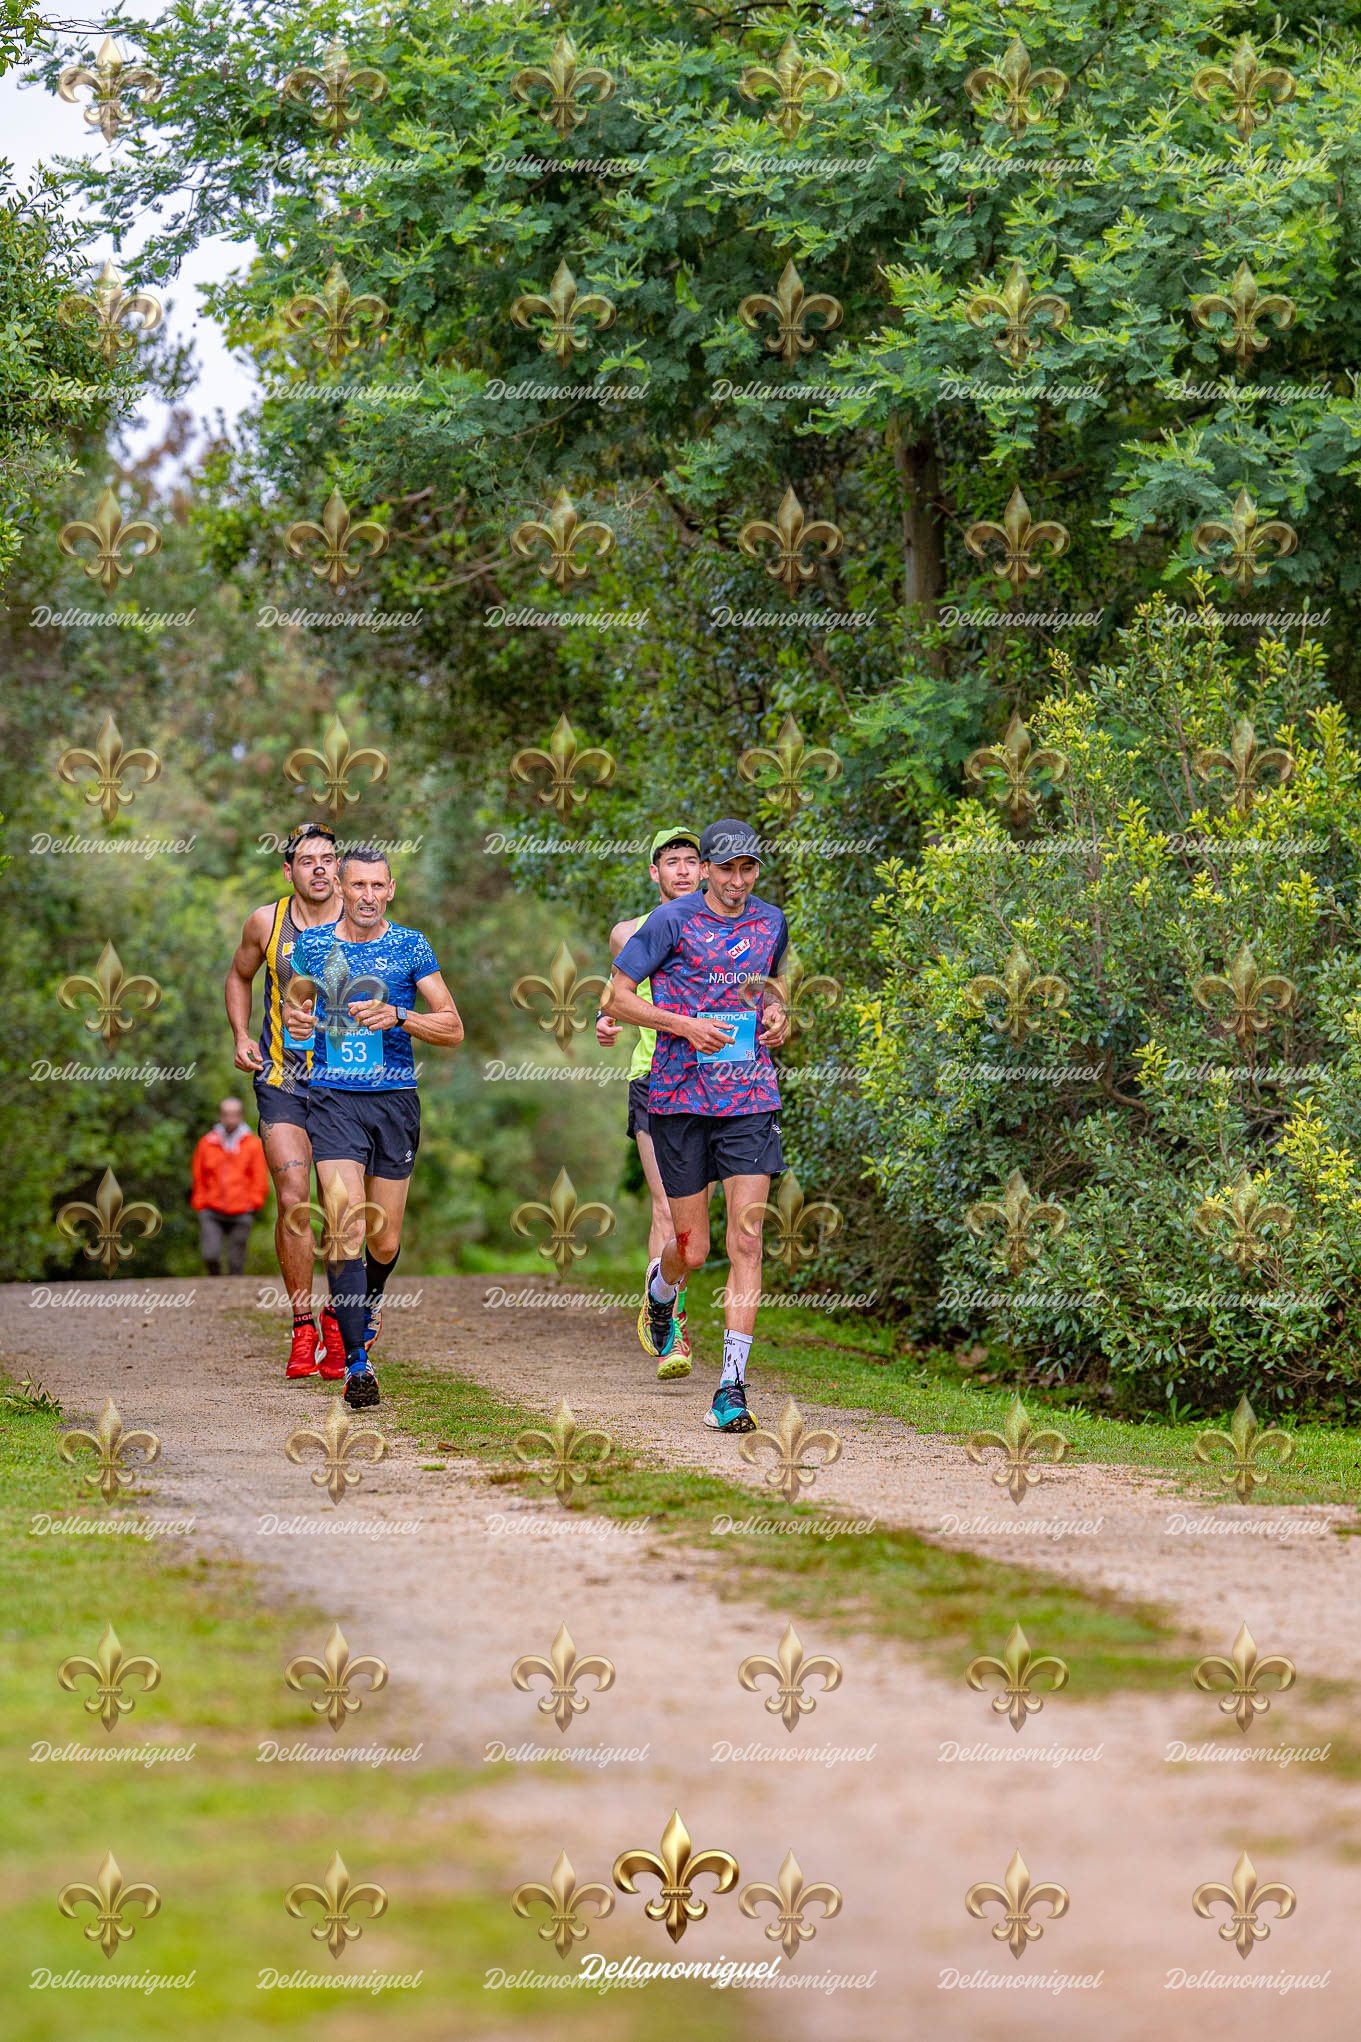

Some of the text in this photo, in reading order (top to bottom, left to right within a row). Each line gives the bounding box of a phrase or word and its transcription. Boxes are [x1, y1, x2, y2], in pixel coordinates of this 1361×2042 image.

[708, 972, 764, 985] NACIONAL
[711, 1012, 749, 1021] VERTICAL
[337, 1028, 375, 1036] VERTICAL
[341, 1041, 367, 1063] 53
